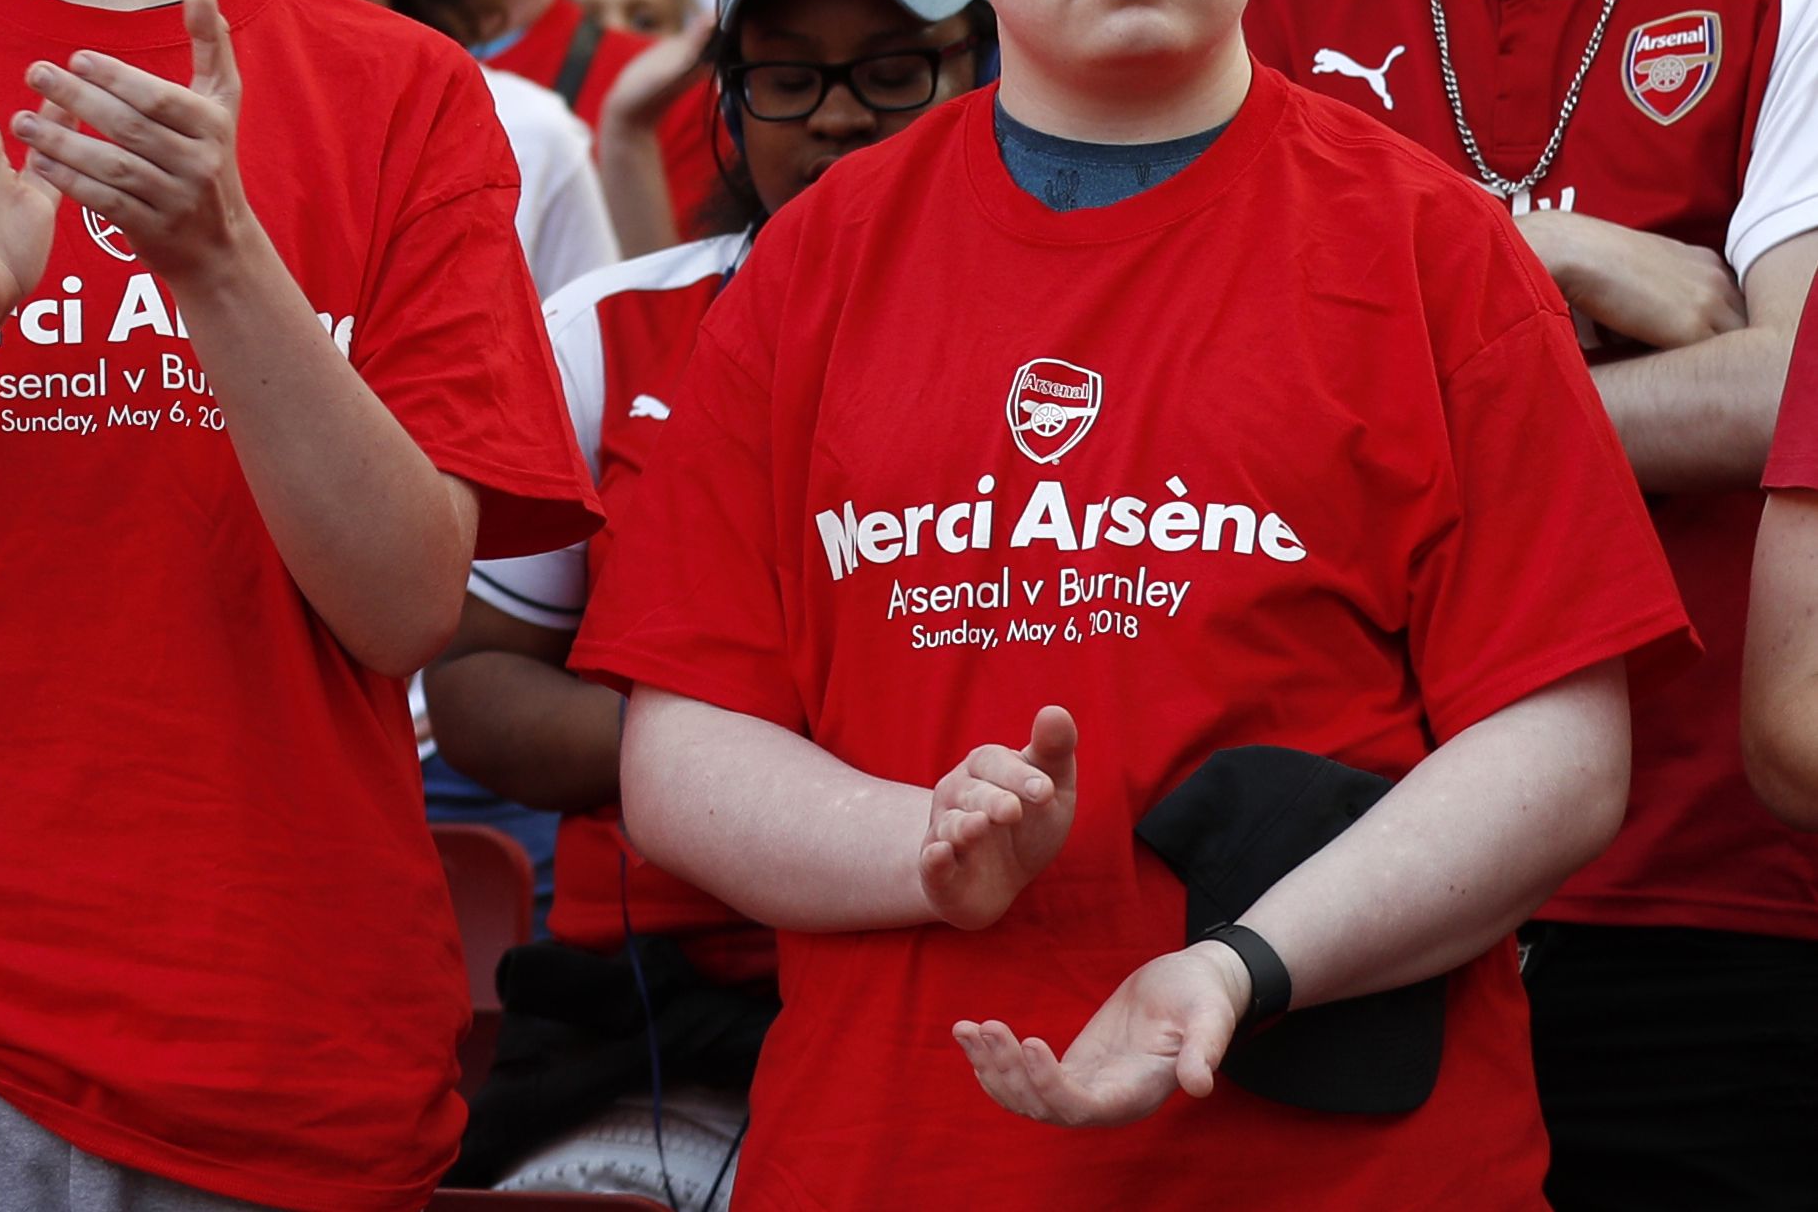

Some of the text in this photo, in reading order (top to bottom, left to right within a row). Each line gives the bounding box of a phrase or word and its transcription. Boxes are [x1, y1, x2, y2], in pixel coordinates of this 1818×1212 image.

[1636, 26, 1704, 51] Arsenal
[122, 368, 146, 394] v
[1022, 373, 1089, 399] Arsenal
[0, 400, 225, 436] Sunday, May 6, 20
[815, 474, 1307, 581] Merci Arsène
[886, 566, 1191, 620] Arsenal v Burnley
[910, 619, 999, 651] Sunday,
[1005, 618, 1057, 647] May
[1062, 616, 1083, 644] 6,
